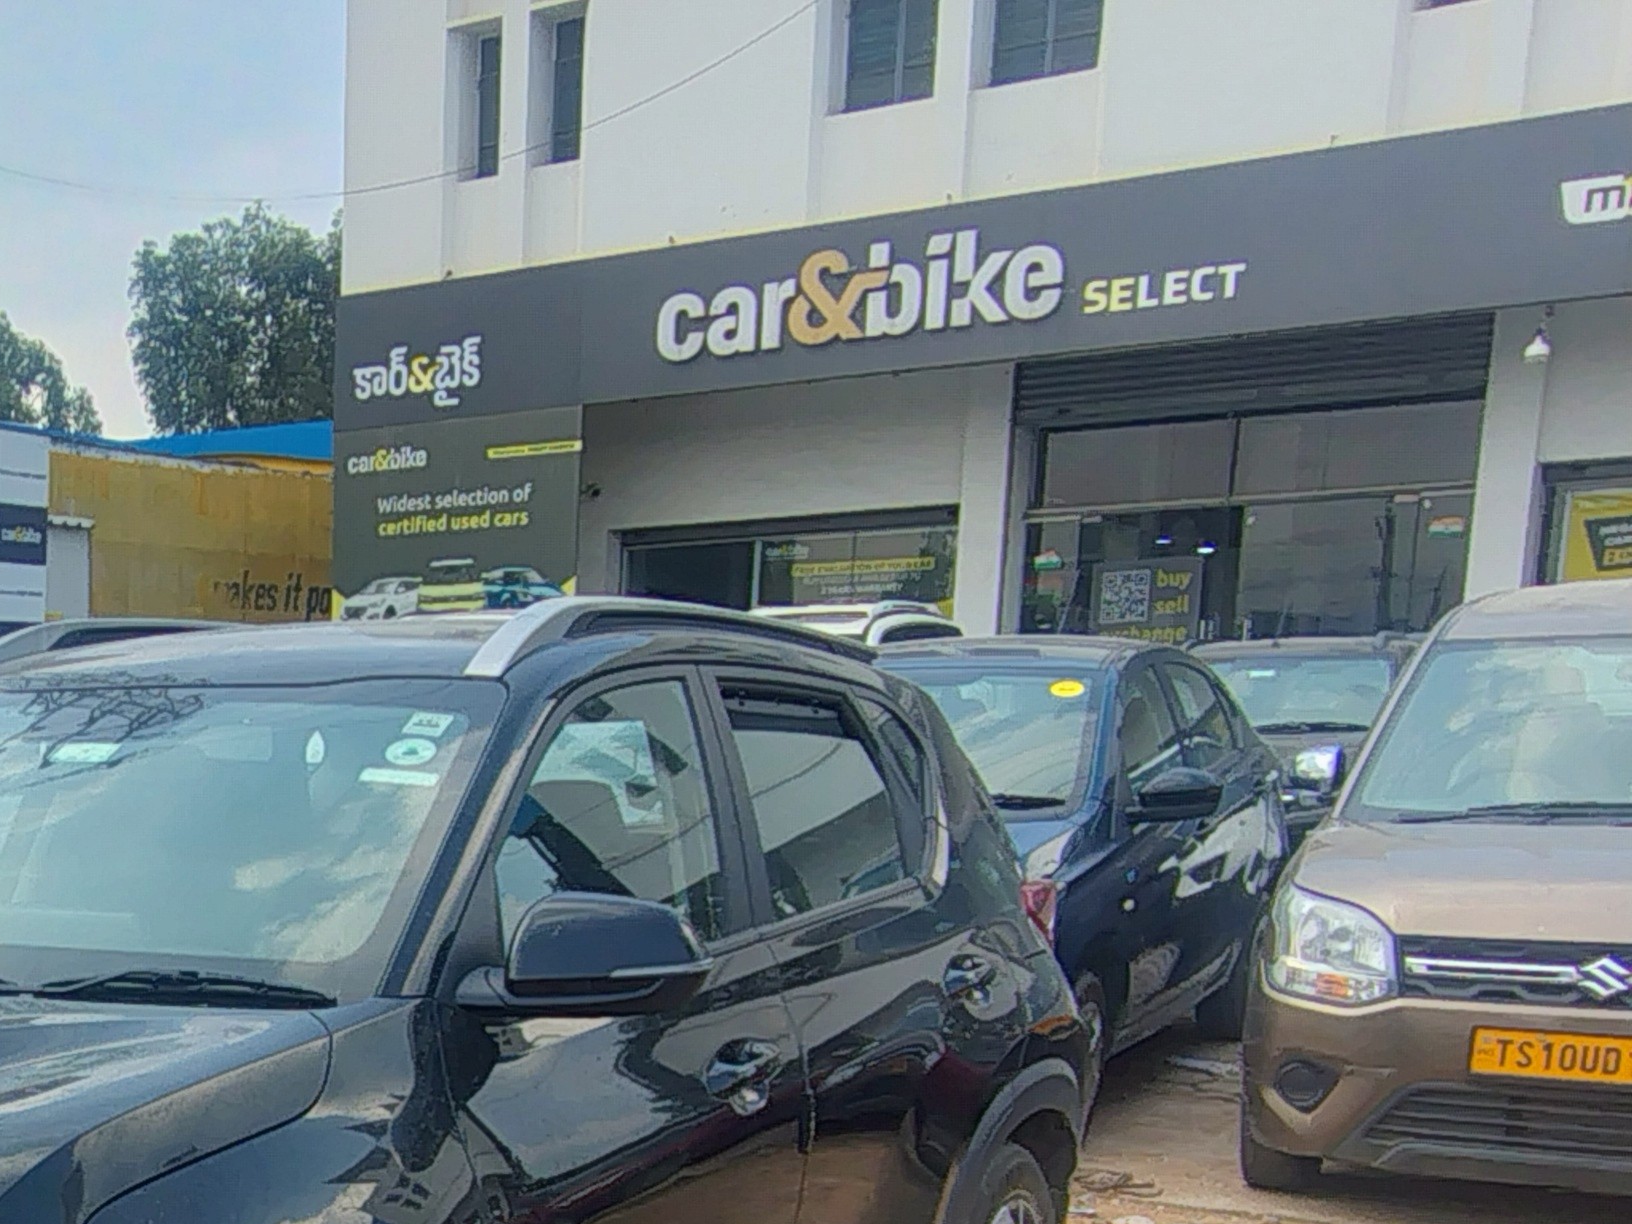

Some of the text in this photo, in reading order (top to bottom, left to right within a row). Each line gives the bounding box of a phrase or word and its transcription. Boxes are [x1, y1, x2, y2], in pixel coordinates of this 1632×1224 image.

[656, 228, 1248, 363] car&bike SELECT
[347, 446, 428, 474] car&bike
[377, 481, 533, 514] Widest selection of
[378, 509, 530, 537] certified used cars
[214, 569, 279, 612] akes
[284, 572, 303, 613] it
[1155, 568, 1192, 590] buy
[1153, 594, 1190, 615] sell
